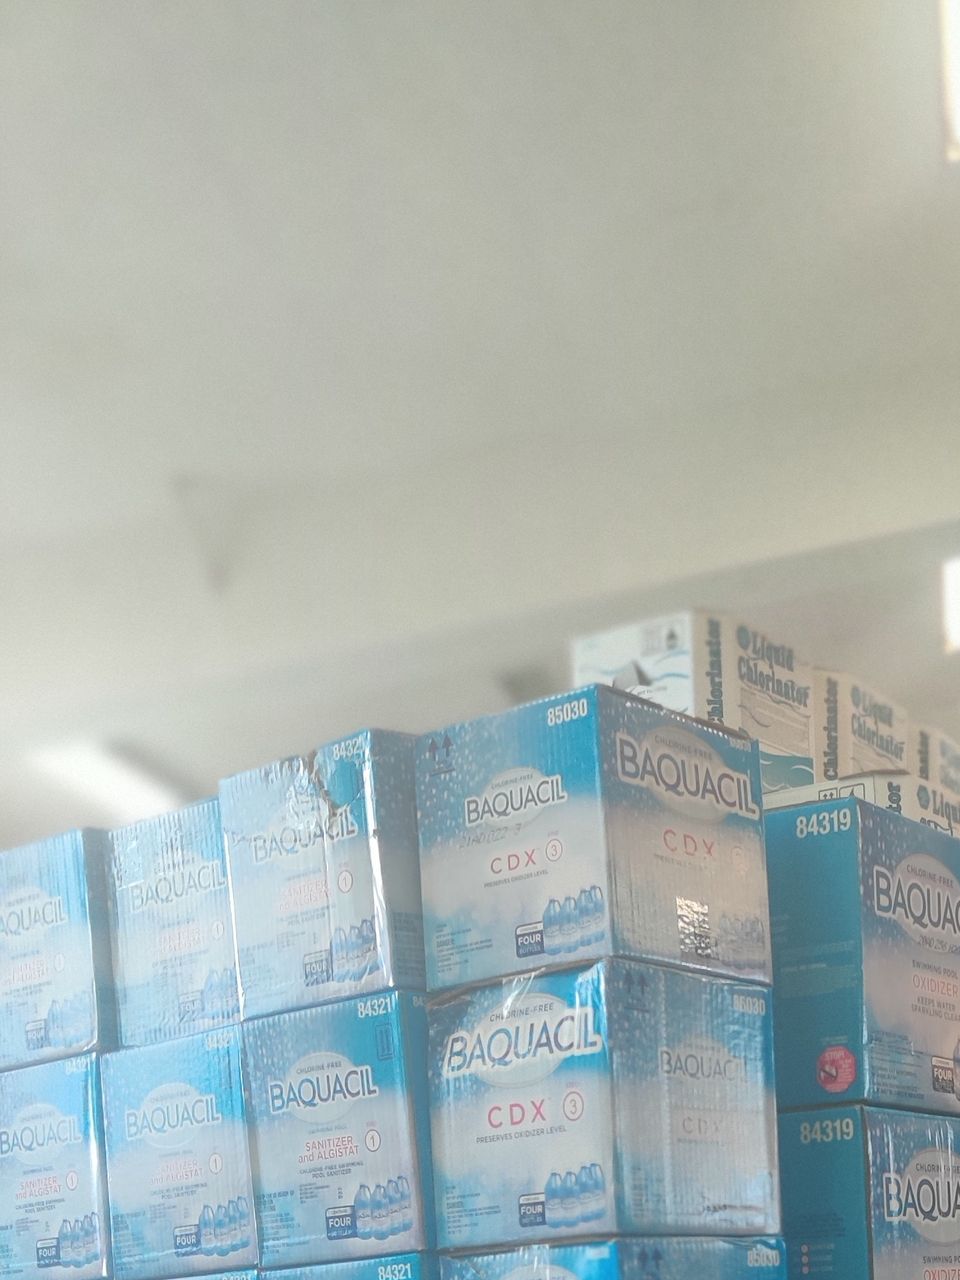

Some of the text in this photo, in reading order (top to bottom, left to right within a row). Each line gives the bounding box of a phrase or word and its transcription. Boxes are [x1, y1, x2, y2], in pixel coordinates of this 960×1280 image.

[752, 632, 794, 672] Liquid
[737, 656, 810, 708] Chlorinator
[547, 699, 588, 726] 85030
[851, 713, 905, 761] Chlorinator
[619, 738, 756, 814] BAQUACIL
[466, 777, 565, 824] BAQUACIL
[796, 809, 851, 838] 84319
[663, 829, 714, 856] CDX
[490, 850, 537, 874] CDX
[131, 864, 225, 912] BAQUACIL
[906, 864, 954, 888] CHLORINE-FREE
[518, 934, 541, 946] FOUR
[305, 958, 327, 973] FOUR
[943, 968, 958, 979] POOL
[913, 974, 958, 998] OXIDIZER
[358, 999, 392, 1018] 84321
[936, 1001, 956, 1011] WATER
[447, 1014, 598, 1073] BAQUACIL
[934, 1068, 952, 1080] FOUR
[270, 1068, 377, 1113] BAQUACIL
[127, 1099, 221, 1137] BAQUACIL
[488, 1099, 546, 1129] CDX
[0, 1118, 82, 1153] BAQUACIL
[305, 1135, 353, 1151] SANITIZER
[476, 1134, 513, 1144] PRESERVES
[546, 1126, 567, 1135] LEVEL
[800, 1118, 854, 1145] 84319
[299, 1145, 359, 1164] and ALGISTAT
[521, 1205, 543, 1215] FOUR
[329, 1217, 351, 1228] FOUR
[176, 1234, 197, 1245] FOUR
[38, 1248, 56, 1256] FOUR
[923, 1256, 952, 1264] SWIMMING
